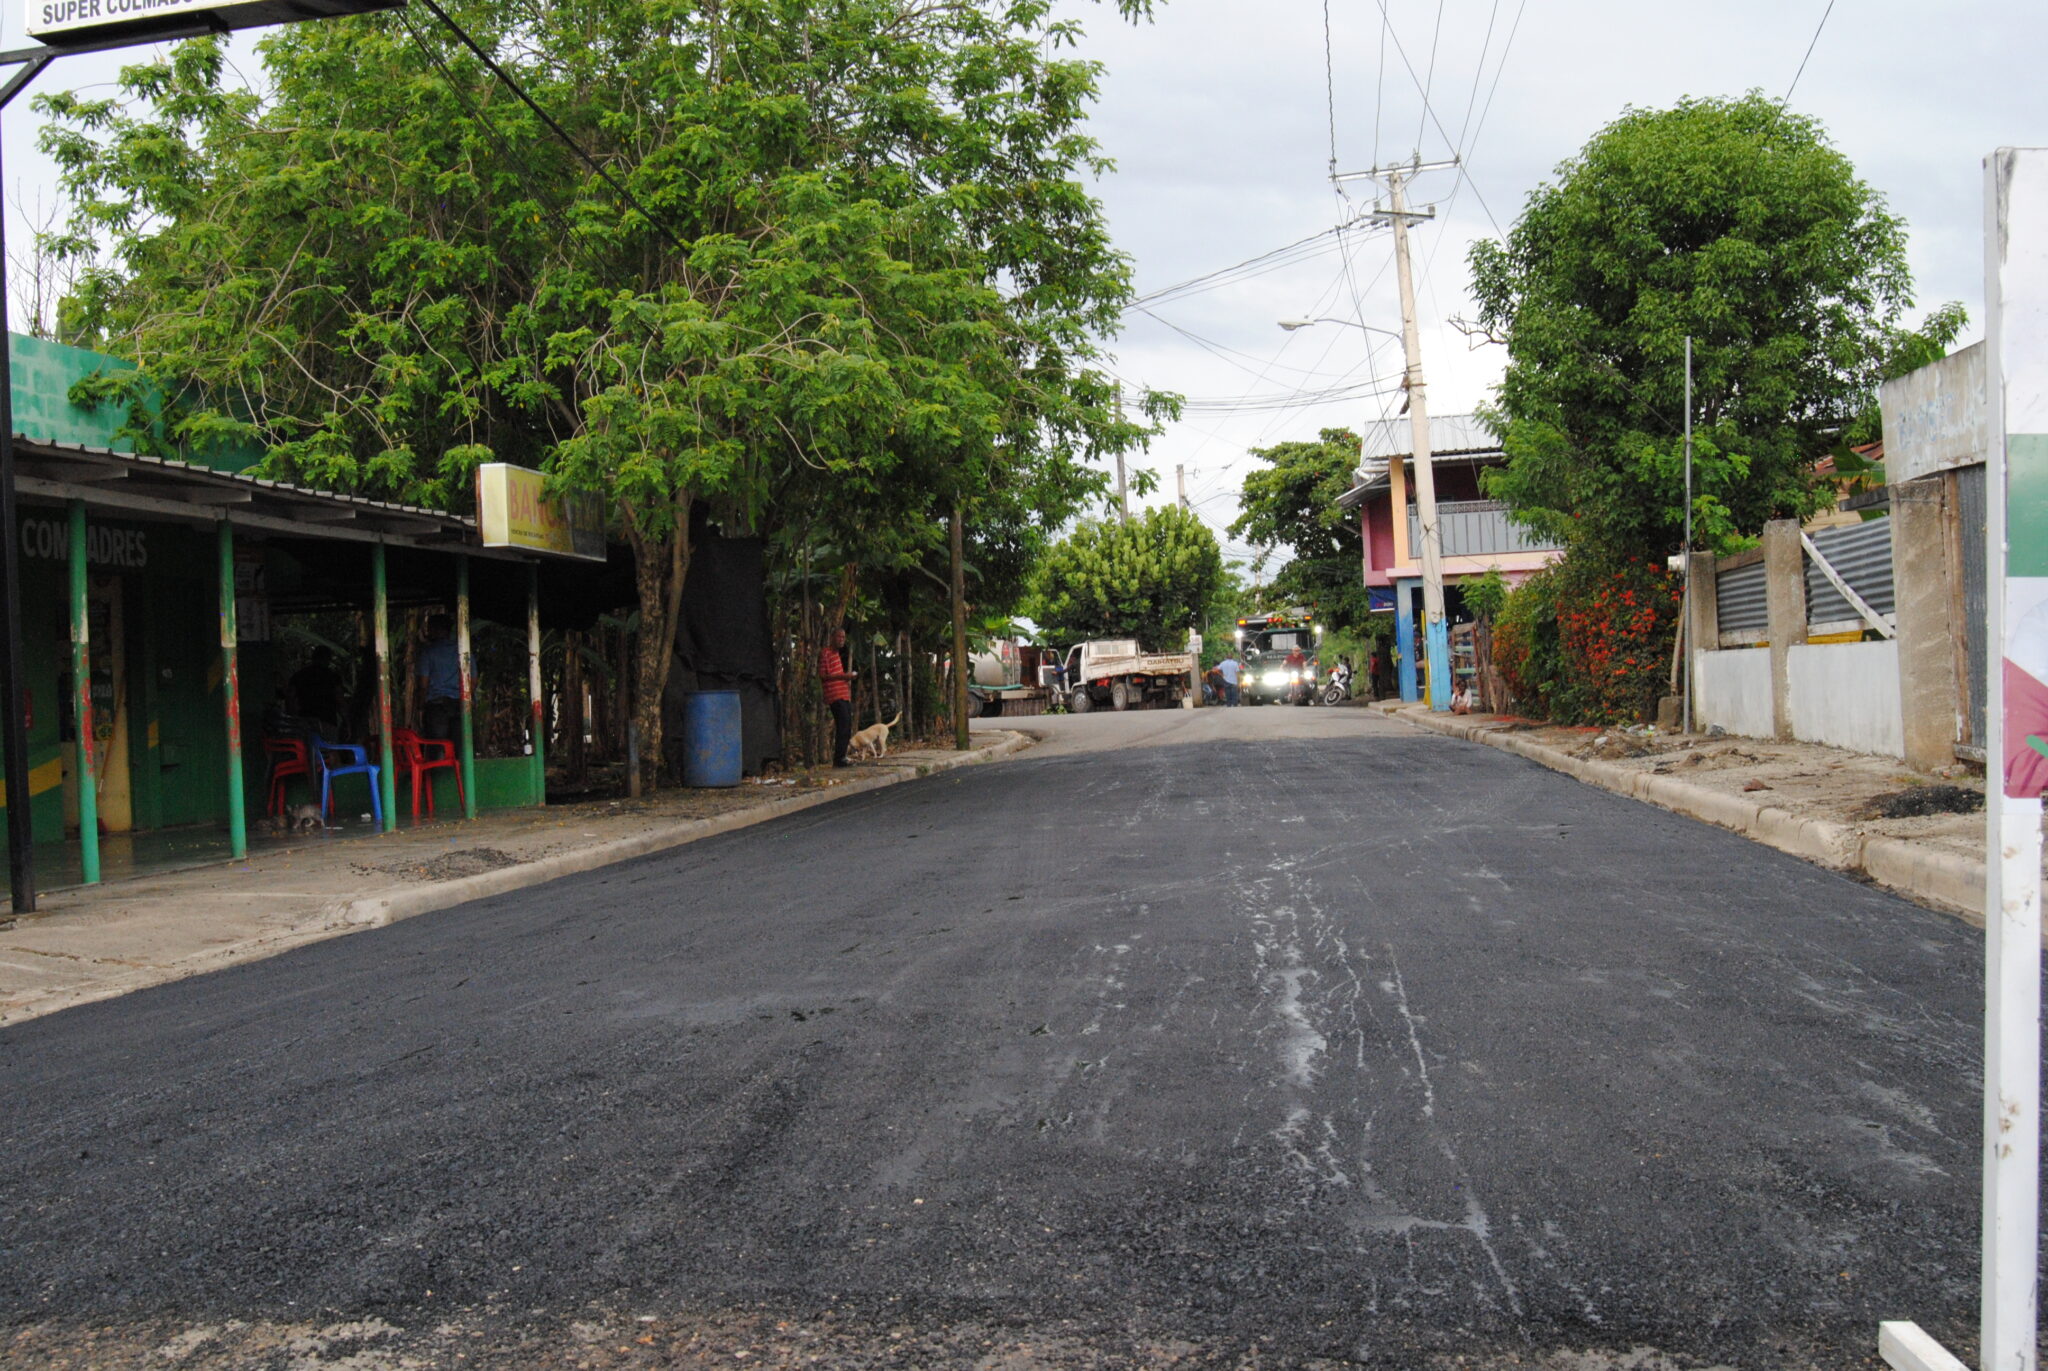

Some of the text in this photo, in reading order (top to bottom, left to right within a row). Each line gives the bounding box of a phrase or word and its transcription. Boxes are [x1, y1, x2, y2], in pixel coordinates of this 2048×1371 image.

[43, 0, 193, 25] SUPER COLM
[509, 479, 570, 529] BANC
[21, 518, 148, 568] COMADRES
